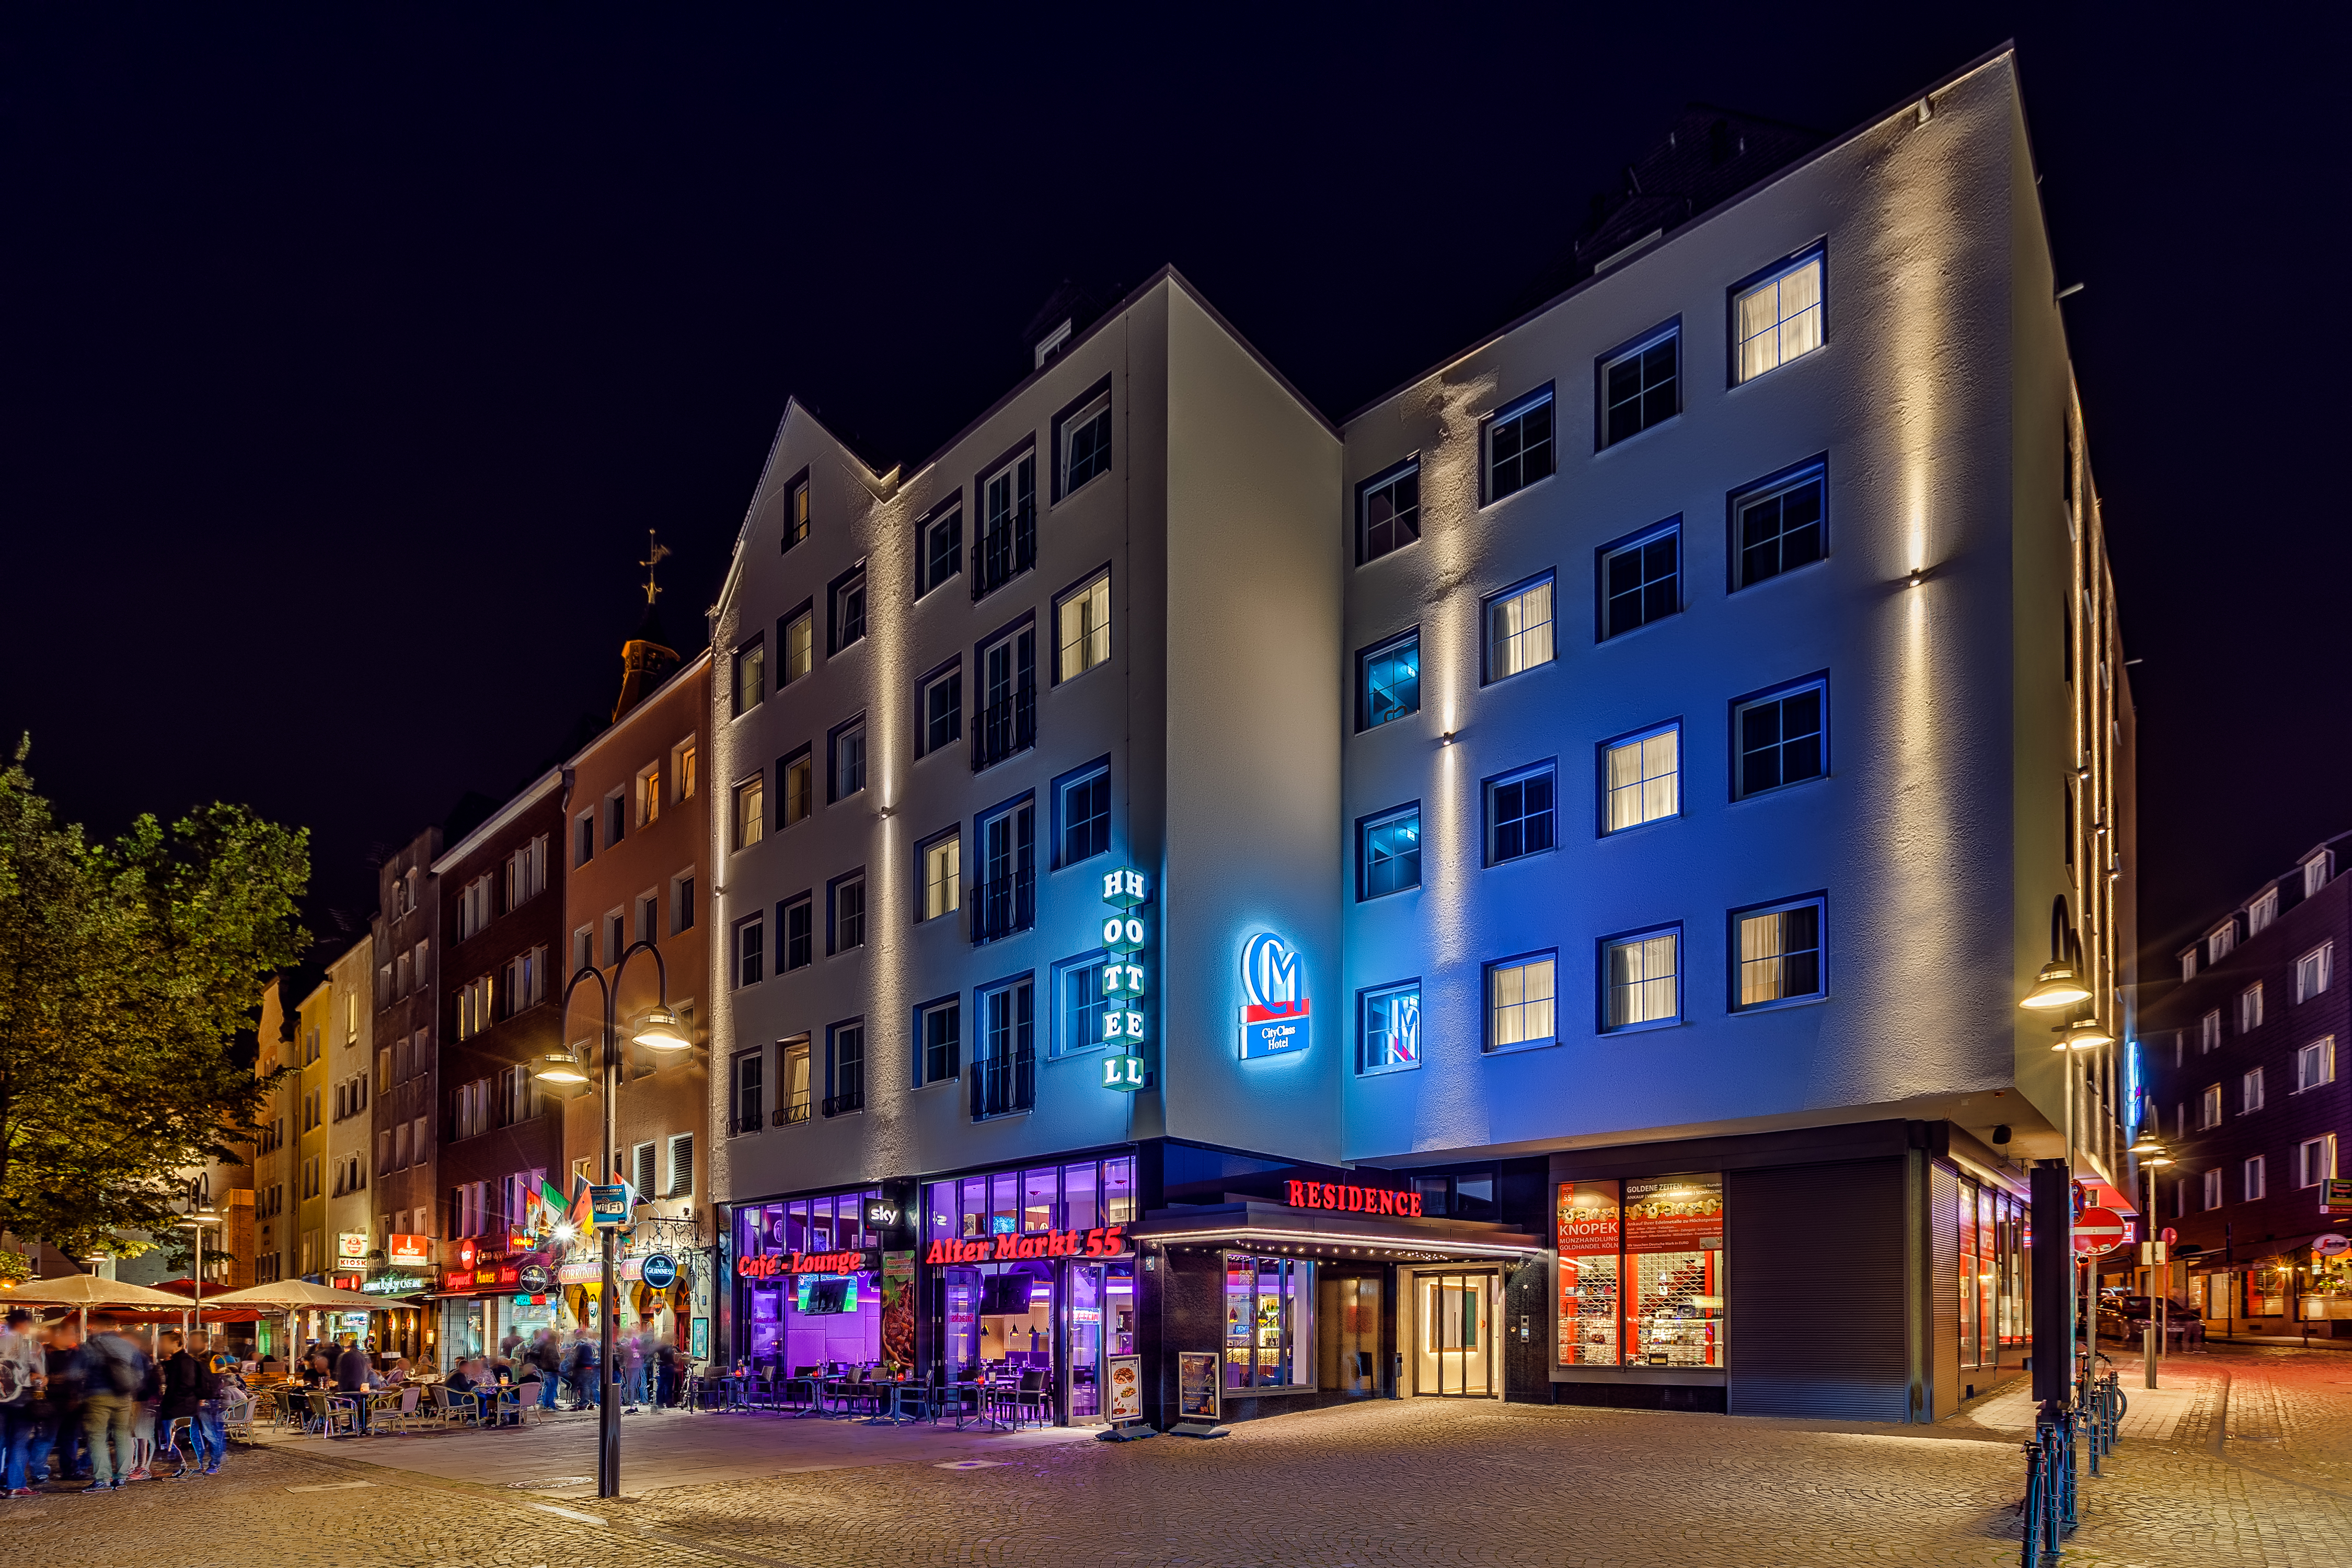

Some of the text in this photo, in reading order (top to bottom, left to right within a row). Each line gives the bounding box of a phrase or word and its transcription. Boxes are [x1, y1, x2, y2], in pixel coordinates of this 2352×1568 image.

[1261, 1025, 1296, 1039] CityClass
[1268, 1037, 1289, 1050] Hotel
[1627, 1184, 1658, 1193] GOLDENE
[1289, 1180, 1422, 1217] RESIDENCE
[871, 1205, 898, 1225] sky
[1560, 1222, 1618, 1236] KNOPEK
[926, 1226, 1122, 1264] Alter Markt 55
[646, 1267, 674, 1276] GUINNESS
[738, 1254, 779, 1280] Café
[791, 1251, 861, 1276] Lounge
[521, 1275, 546, 1284] GUINNESS
